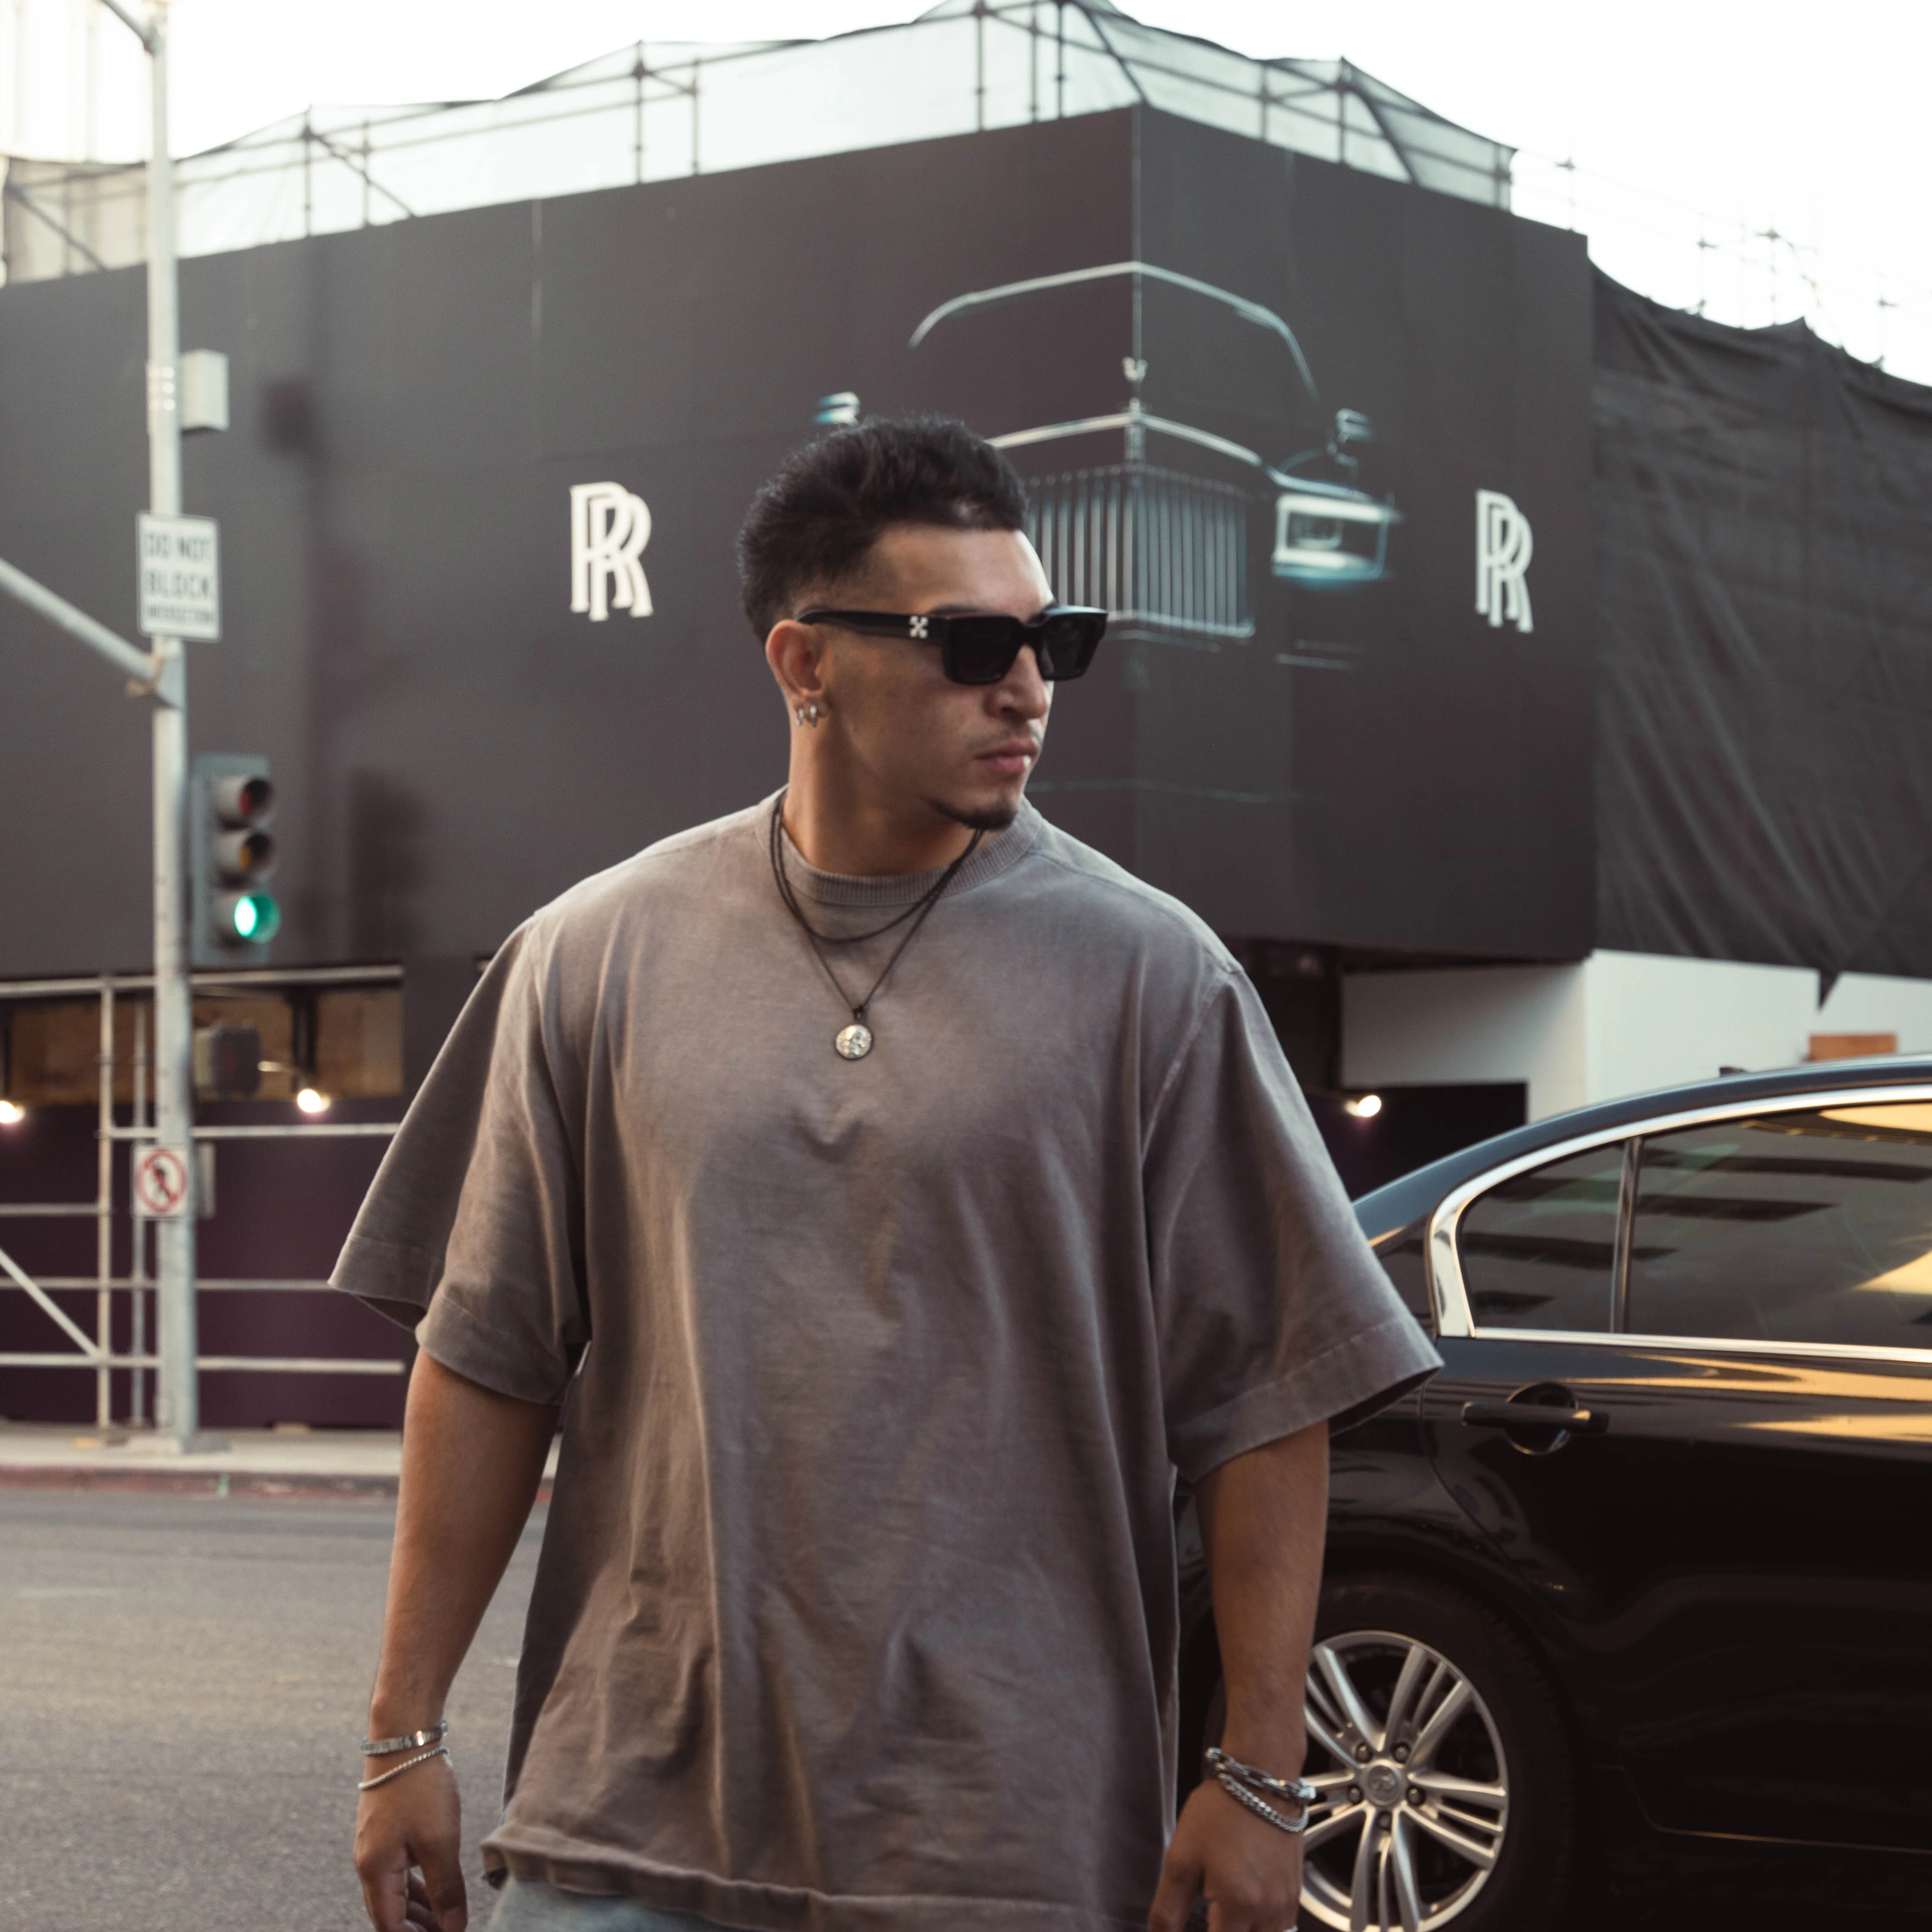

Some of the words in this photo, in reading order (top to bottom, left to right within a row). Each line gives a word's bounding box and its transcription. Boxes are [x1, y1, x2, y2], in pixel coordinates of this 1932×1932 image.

[142, 533, 171, 557] DO
[175, 536, 211, 562] NOT
[142, 568, 212, 599] BLOCK
[570, 481, 653, 622] RR
[1475, 488, 1535, 633] RR
